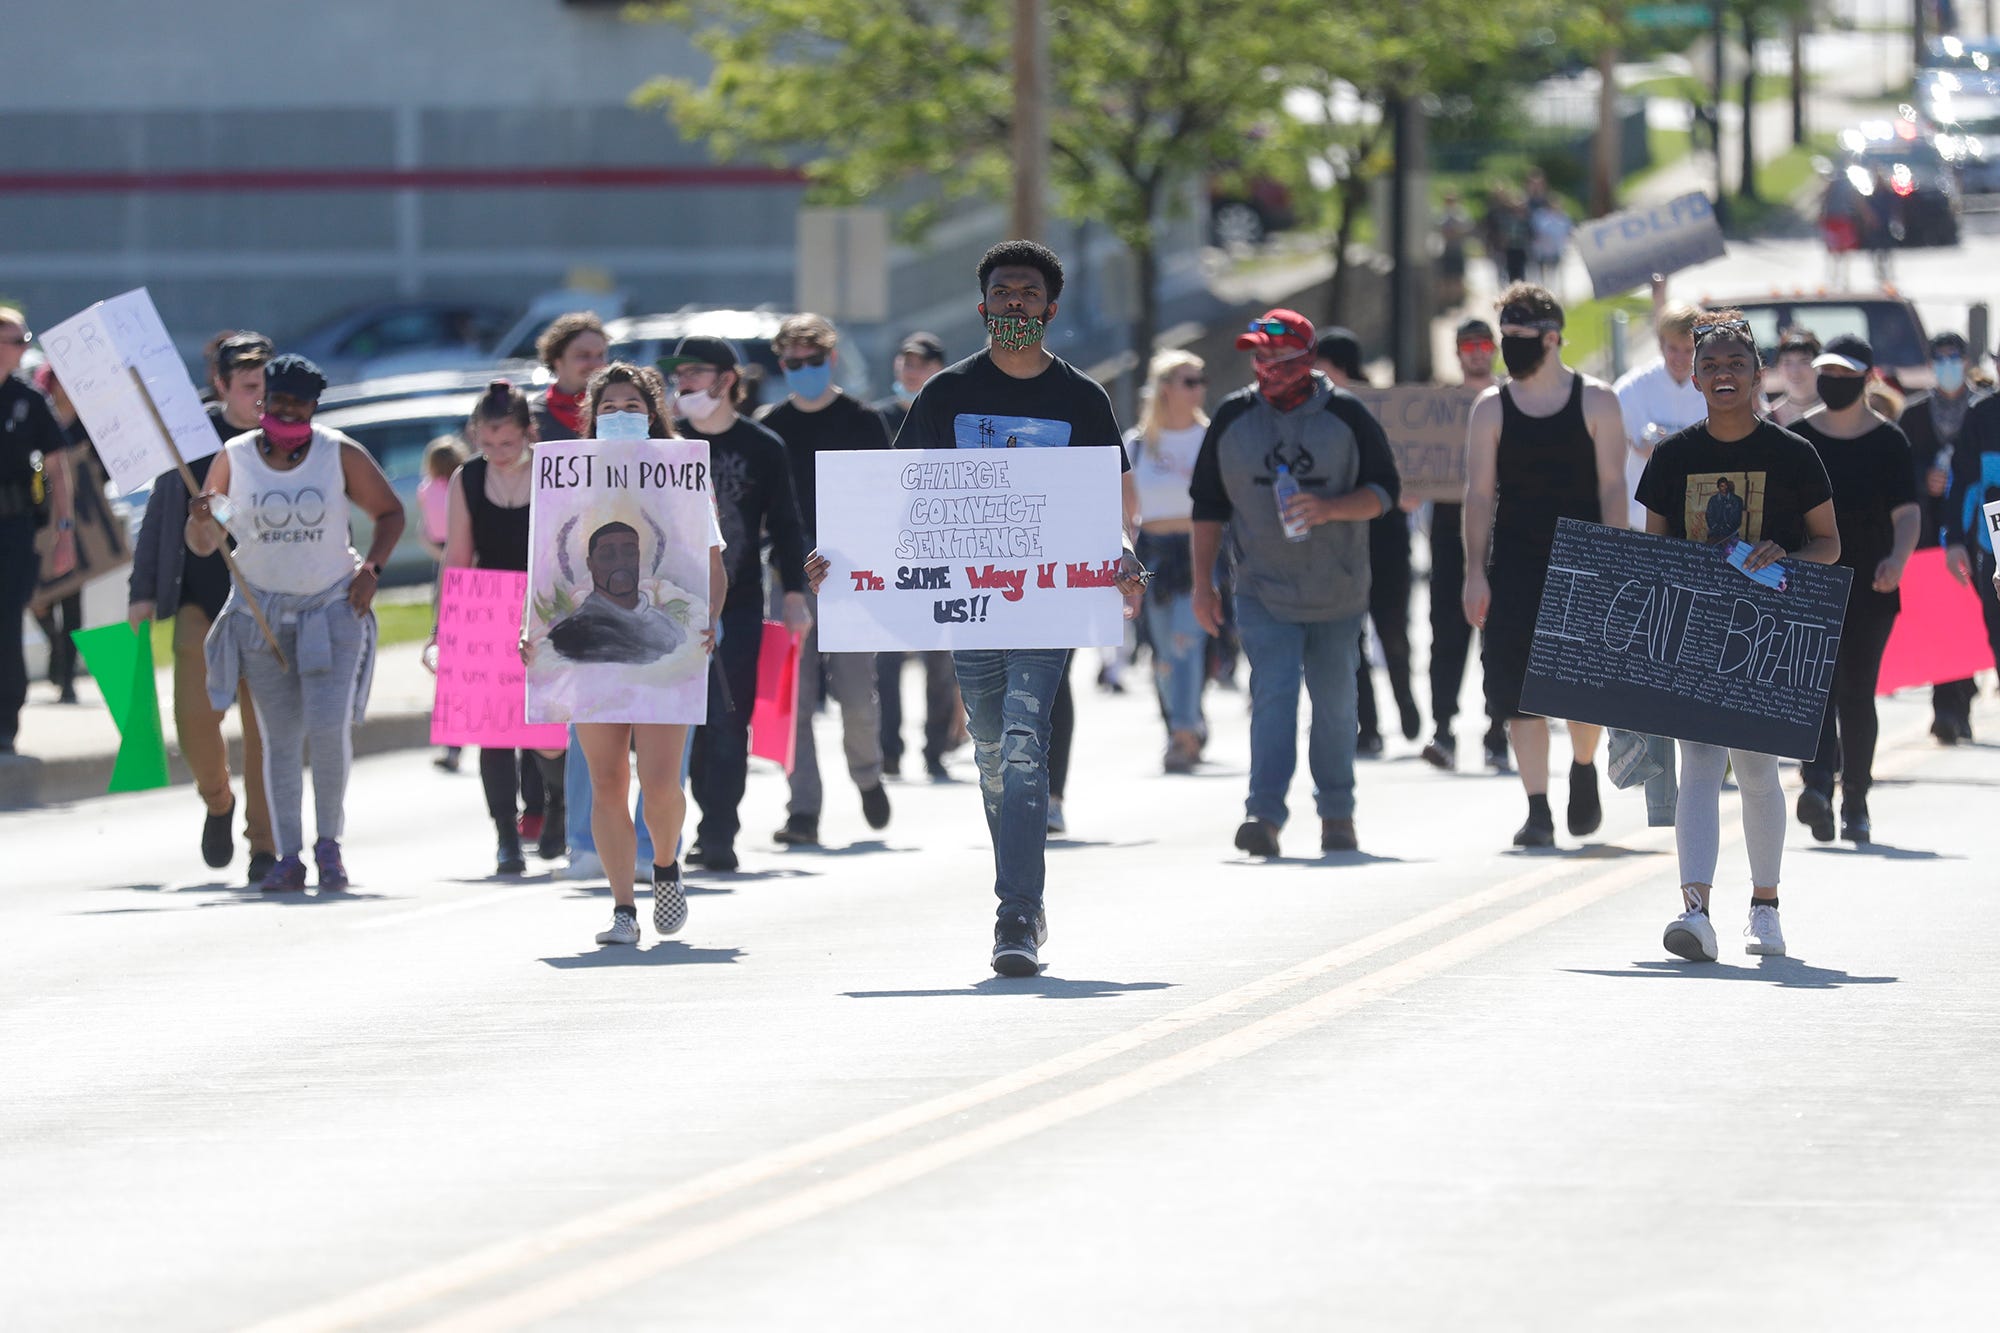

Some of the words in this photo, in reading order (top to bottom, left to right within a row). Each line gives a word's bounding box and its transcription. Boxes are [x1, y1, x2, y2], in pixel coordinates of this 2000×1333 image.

[540, 454, 598, 489] REST
[607, 464, 628, 489] IN
[639, 461, 707, 492] POWER
[901, 460, 1011, 490] CHARGE
[251, 486, 326, 529] 100
[910, 494, 1047, 525] CONVICT
[895, 526, 1043, 560] SENTENCE
[850, 570, 885, 592] The
[895, 565, 951, 591] SAME
[965, 564, 1028, 602] Way
[1037, 562, 1058, 589] U
[1535, 565, 1600, 641] I
[1717, 599, 1840, 692] BREATHE
